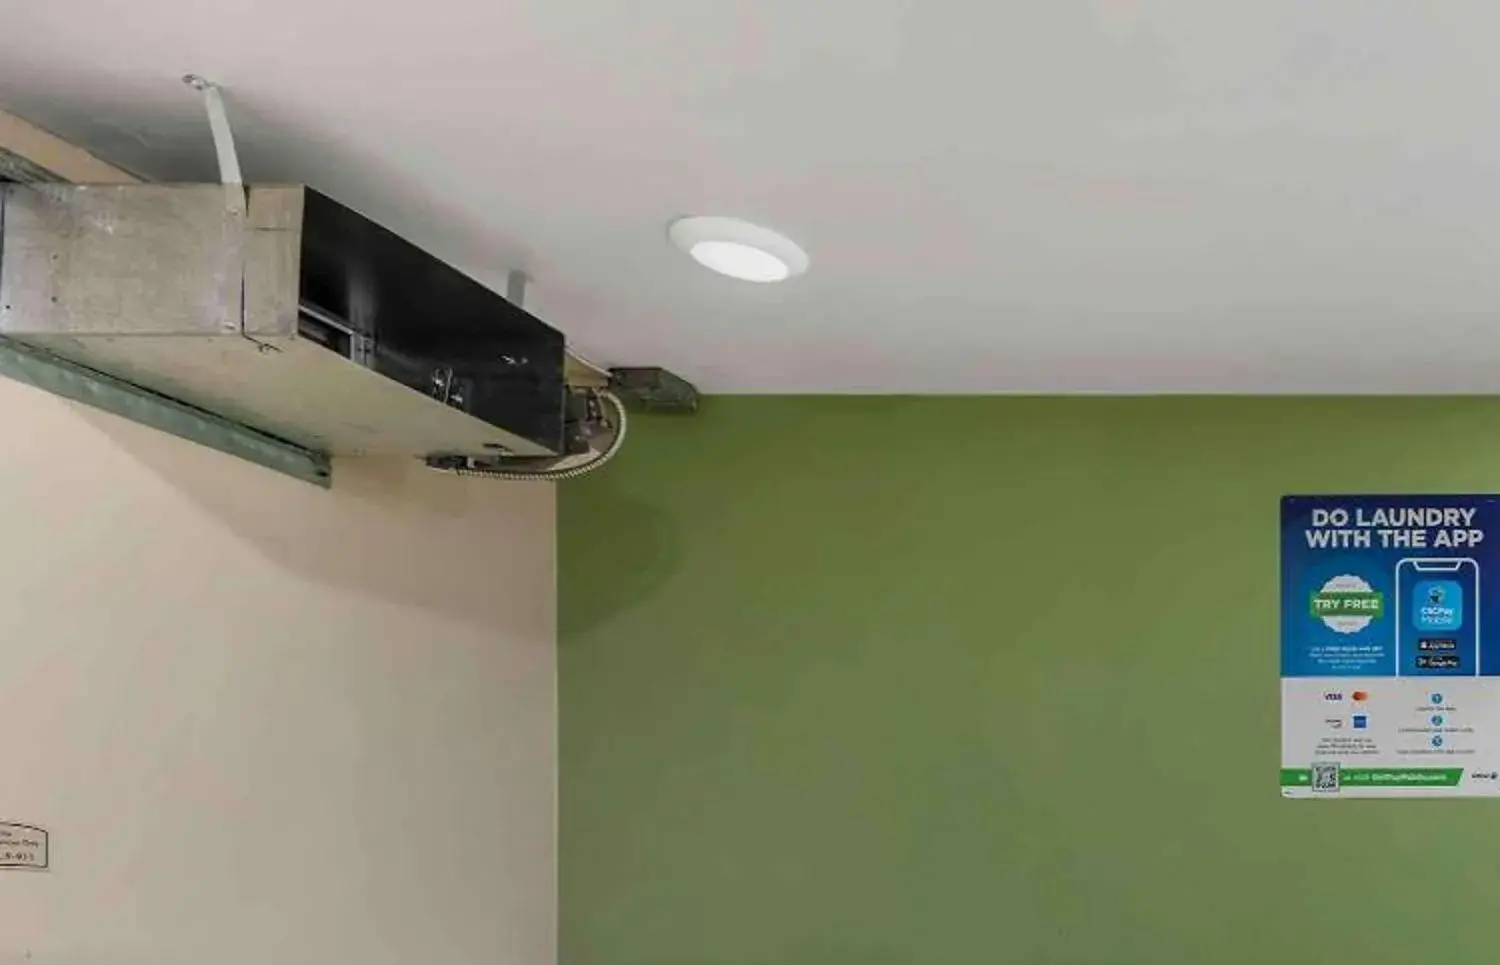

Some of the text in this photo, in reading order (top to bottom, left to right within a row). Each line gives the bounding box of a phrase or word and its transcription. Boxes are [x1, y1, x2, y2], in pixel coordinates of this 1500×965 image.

[1312, 508, 1477, 527] DO LAUNDRY
[1305, 530, 1485, 548] WITH THE APP
[1313, 599, 1379, 609] TRY FREE
